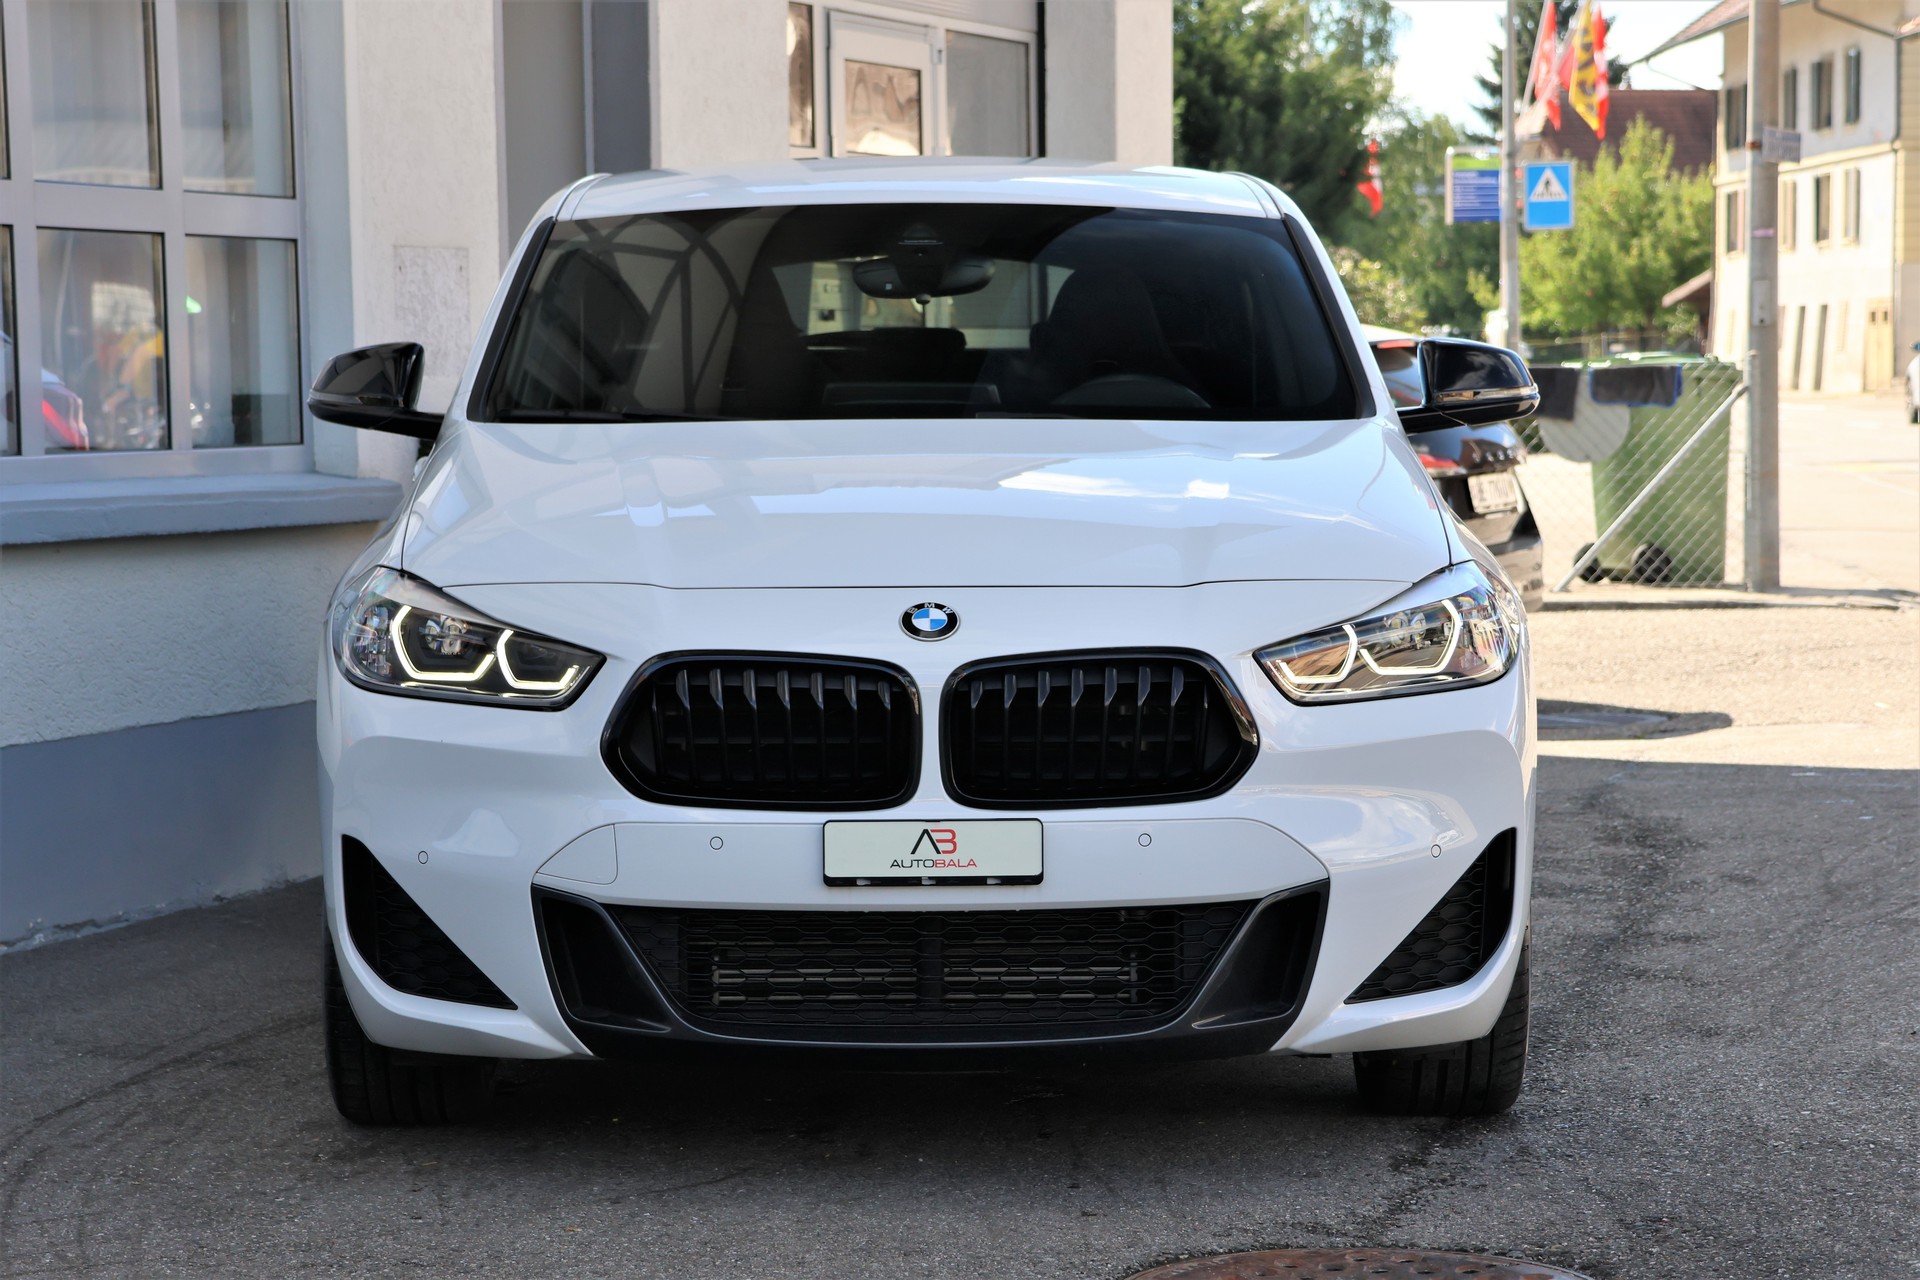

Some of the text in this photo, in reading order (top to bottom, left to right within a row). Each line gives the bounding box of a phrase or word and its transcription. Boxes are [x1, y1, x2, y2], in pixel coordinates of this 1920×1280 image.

[907, 603, 953, 614] BMW
[910, 828, 957, 855] AB
[890, 858, 978, 869] AUTOBALA
